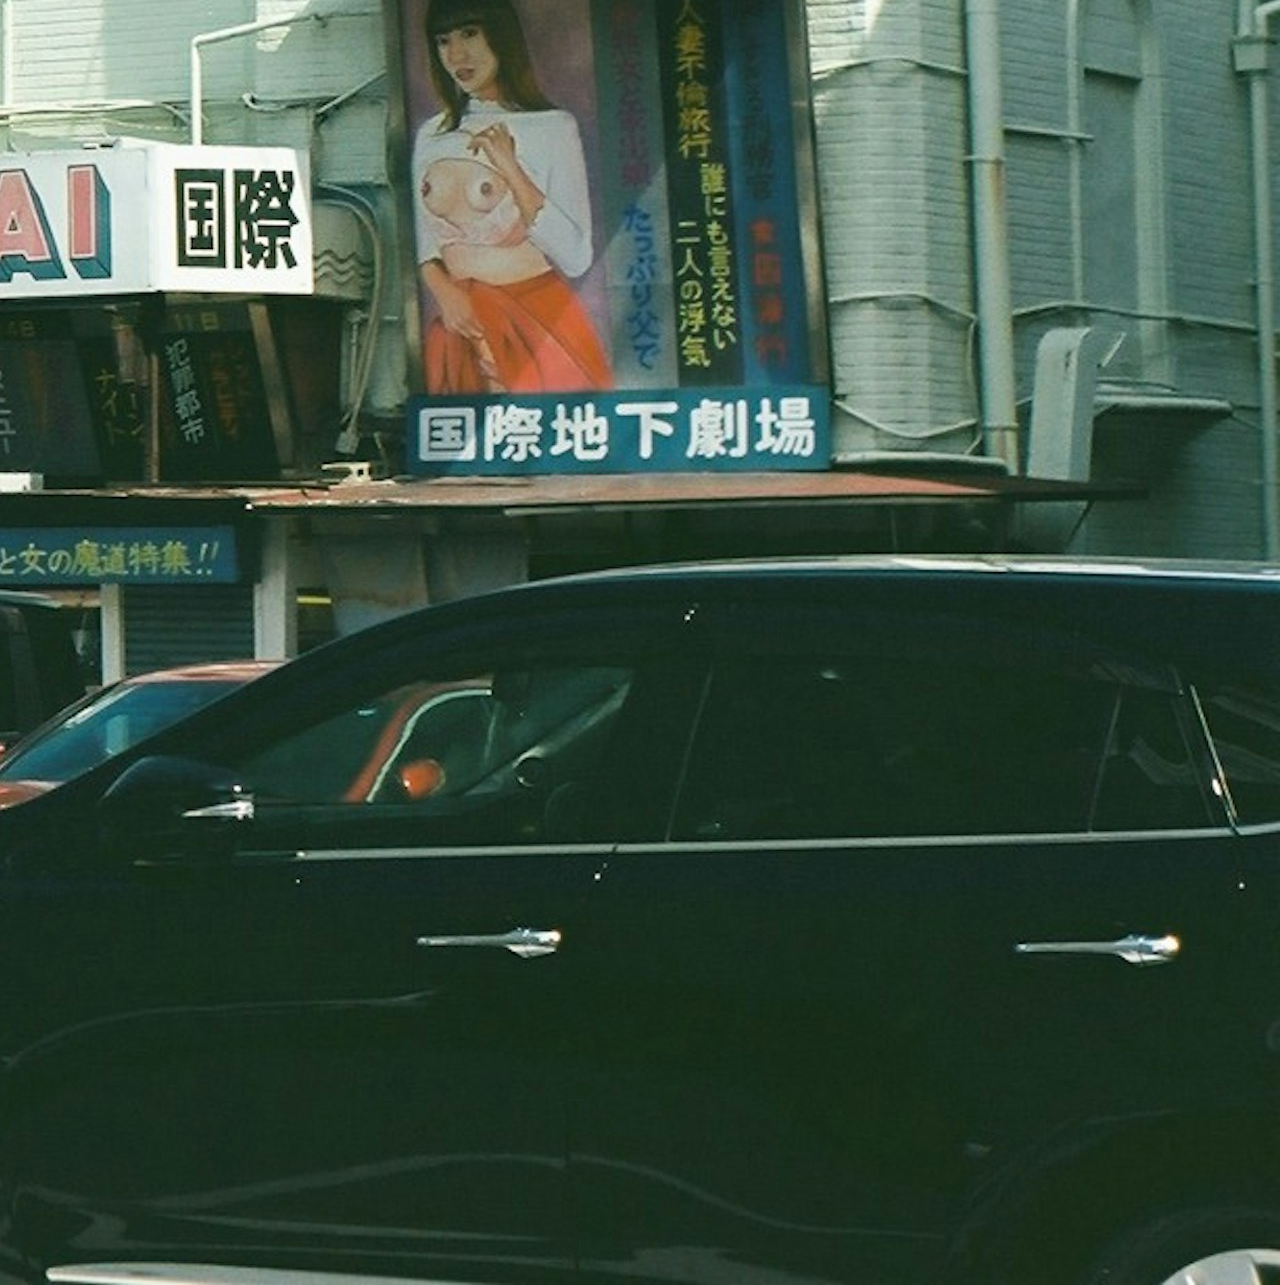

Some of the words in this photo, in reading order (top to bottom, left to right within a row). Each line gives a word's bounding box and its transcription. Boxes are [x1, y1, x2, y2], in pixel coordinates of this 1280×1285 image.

[175, 167, 299, 270] 国際
[700, 163, 737, 350] 誰にも言えない
[675, 220, 711, 368] 二人の浮気
[165, 338, 206, 445] 犯罪都市
[417, 396, 816, 463] 国際地下劇場
